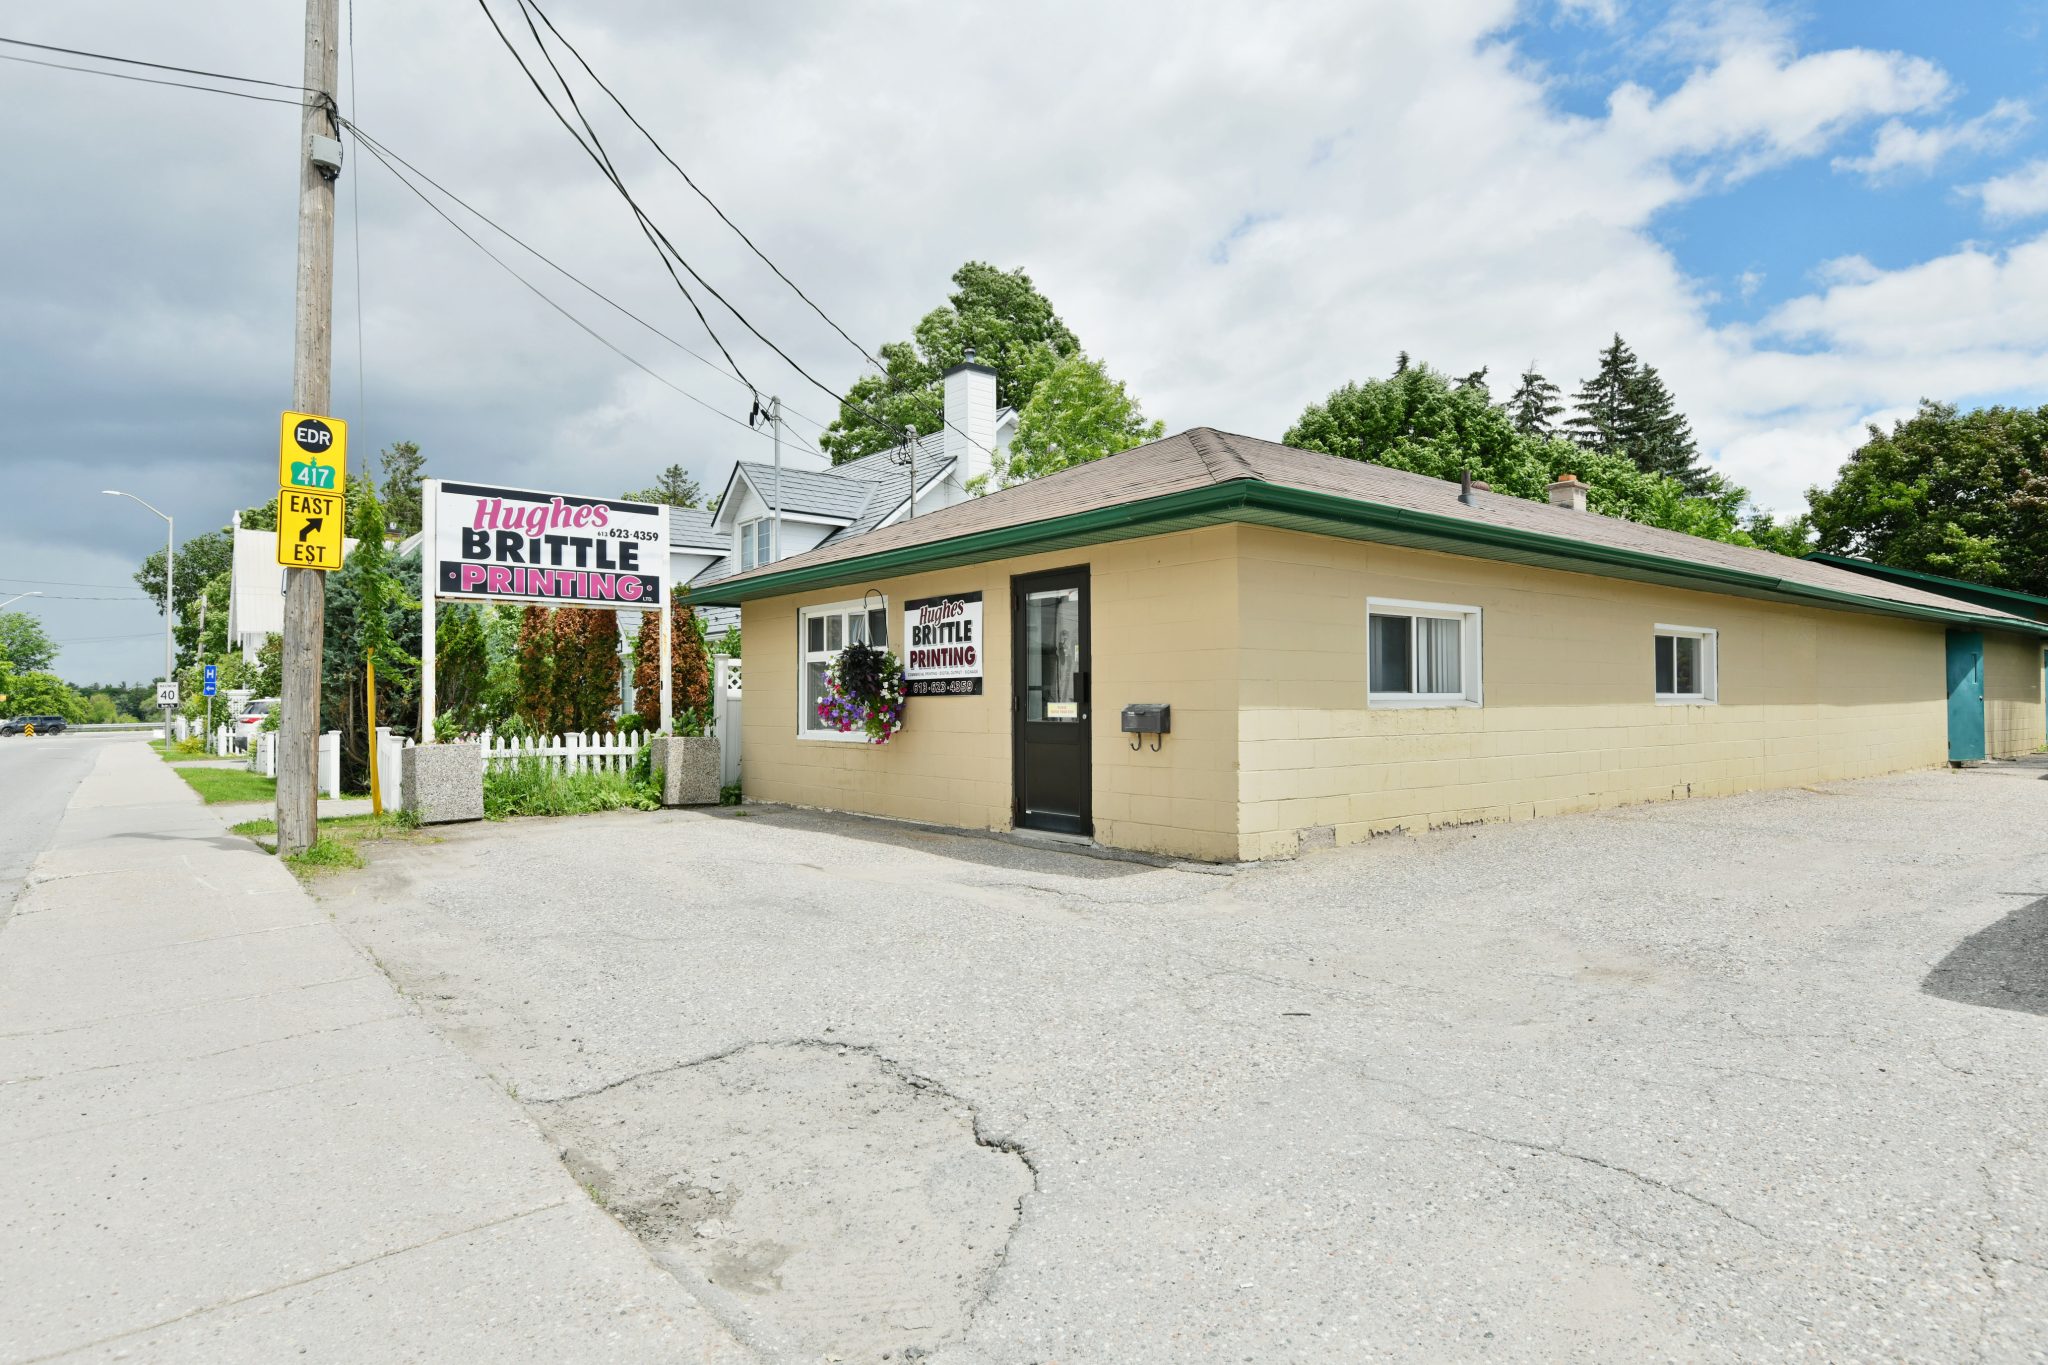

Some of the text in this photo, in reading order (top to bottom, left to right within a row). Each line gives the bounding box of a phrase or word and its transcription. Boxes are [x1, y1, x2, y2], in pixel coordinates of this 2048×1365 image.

[297, 427, 331, 446] EDR
[297, 466, 329, 487] 417
[291, 495, 333, 516] EAST
[472, 497, 610, 538] Hughes
[294, 544, 326, 564] EST
[462, 527, 639, 571] BRITTLE
[460, 564, 644, 600] PRINTING
[919, 599, 965, 627] Hughes
[912, 619, 972, 647] BRITTLE
[909, 645, 977, 669] PRINTING
[206, 669, 215, 679] H
[160, 690, 175, 700] 40
